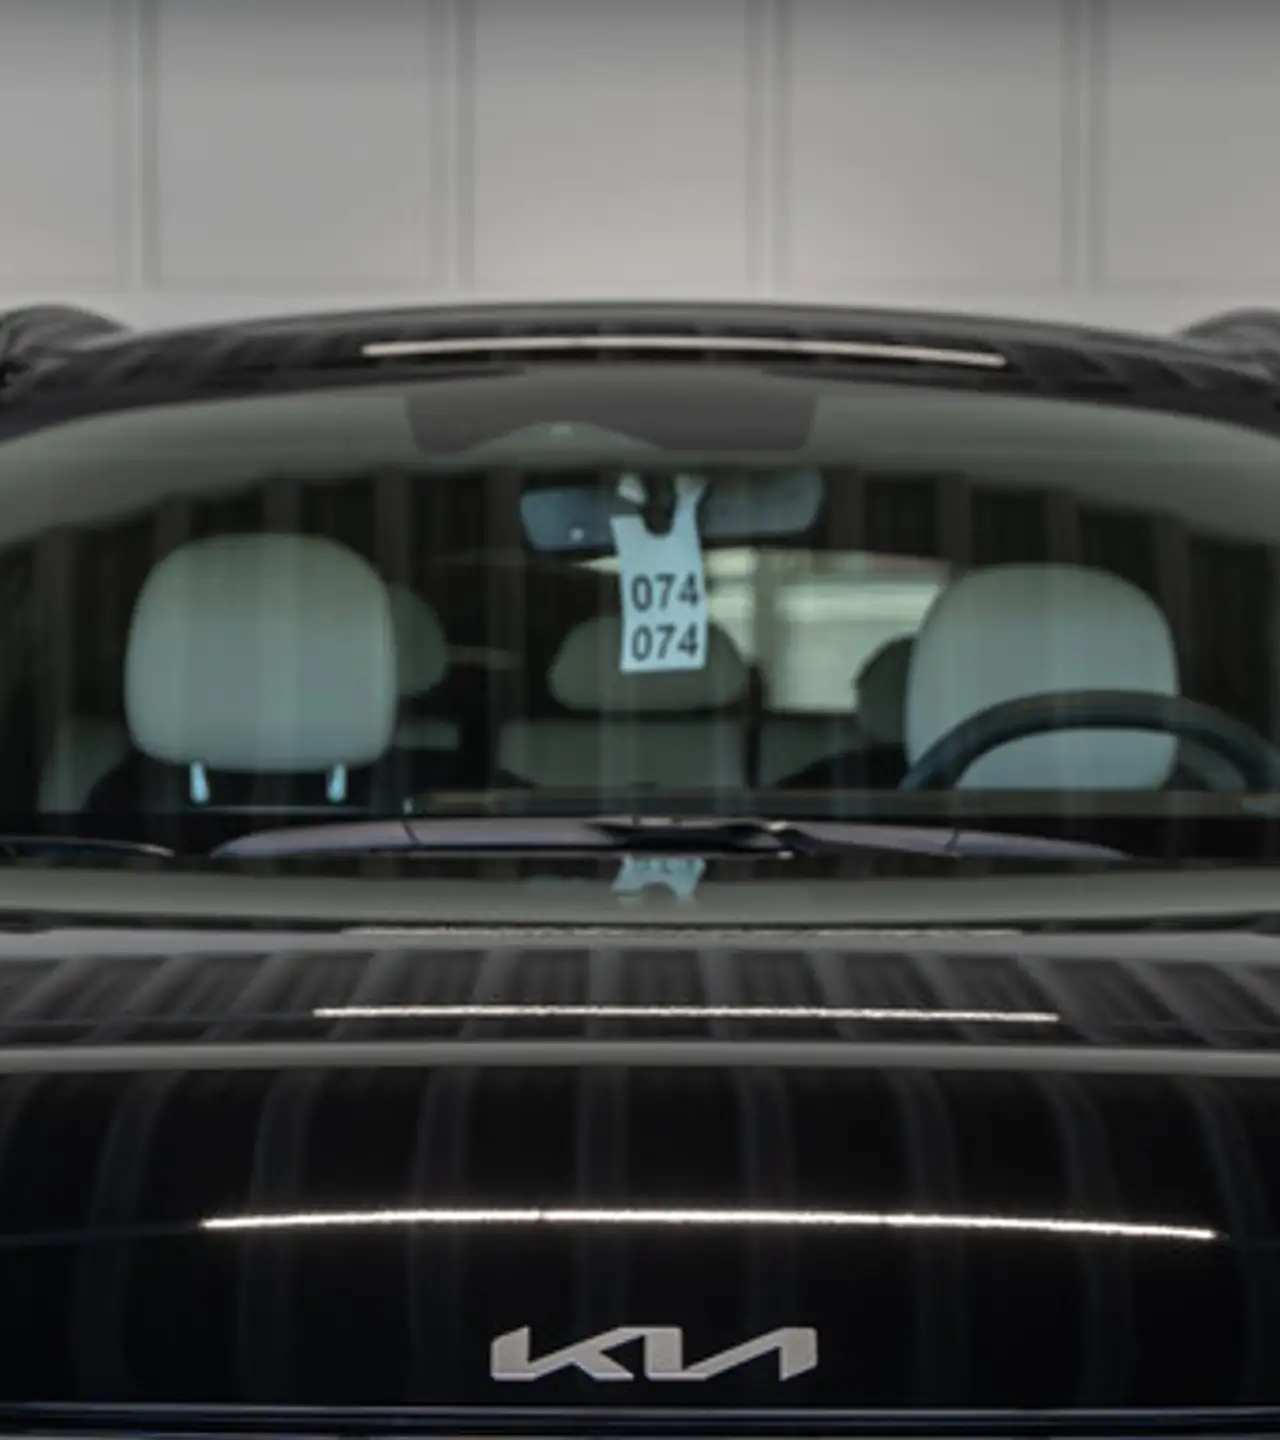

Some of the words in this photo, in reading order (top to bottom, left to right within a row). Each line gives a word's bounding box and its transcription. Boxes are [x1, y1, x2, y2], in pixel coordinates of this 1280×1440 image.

[630, 572, 699, 612] 074
[630, 622, 699, 661] 074
[490, 1325, 818, 1382] KIA
